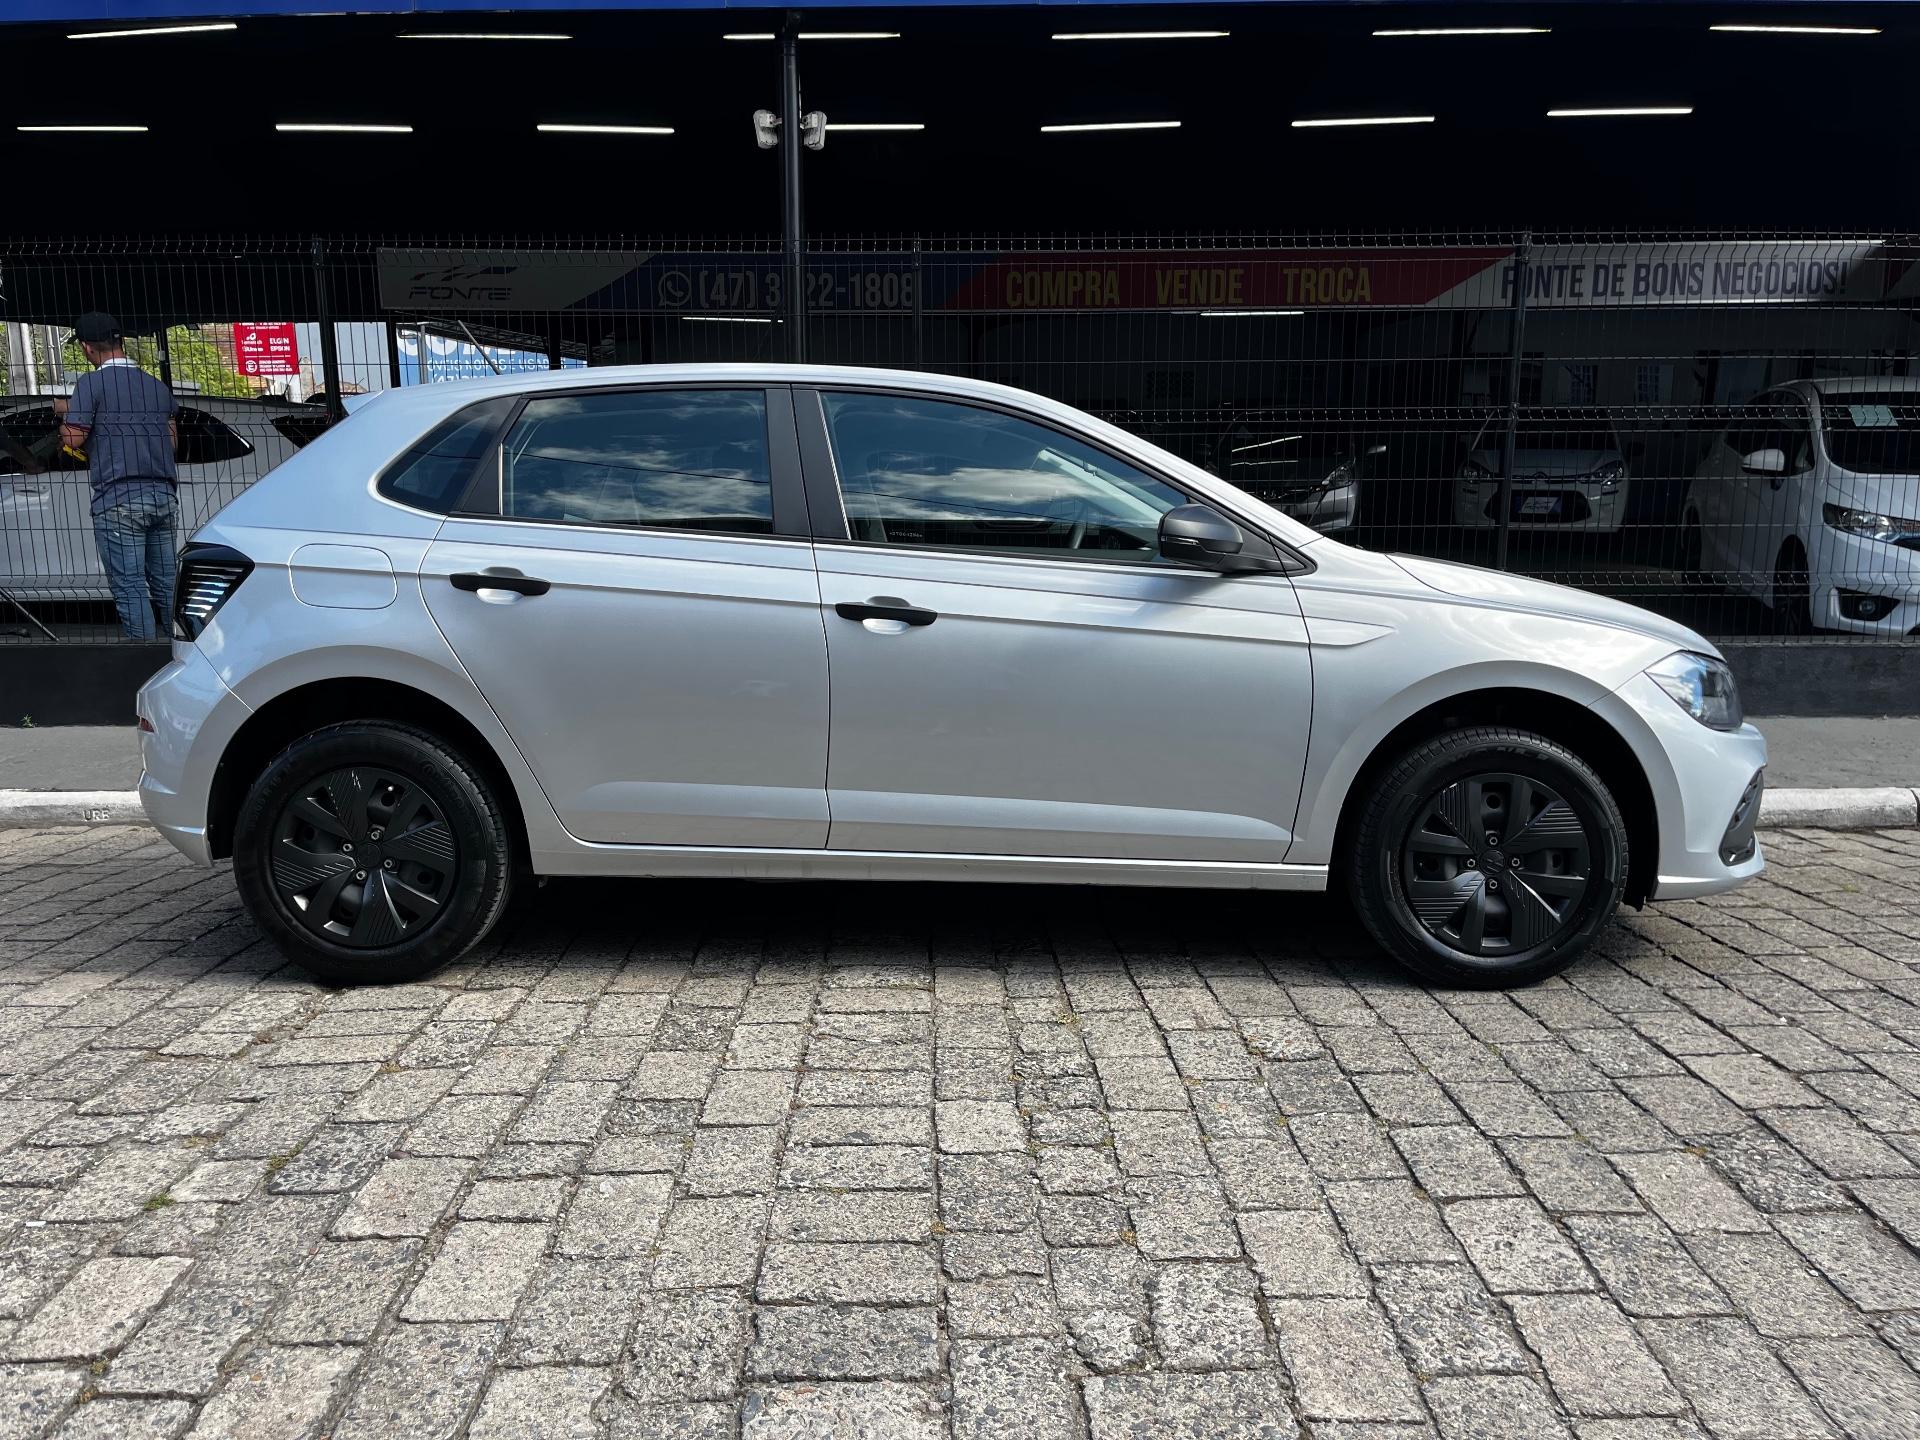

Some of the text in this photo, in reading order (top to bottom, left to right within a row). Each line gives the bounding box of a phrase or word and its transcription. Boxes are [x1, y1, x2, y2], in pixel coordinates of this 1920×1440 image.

[699, 270, 914, 308] (47) 322-1808
[1006, 266, 1373, 307] COMPRA VENDE TROCA
[1592, 263, 1627, 297] DE
[1633, 262, 1704, 296] BONS
[408, 285, 511, 301] FONTE
[270, 337, 290, 345] ELGIN
[519, 358, 567, 370] USADS
